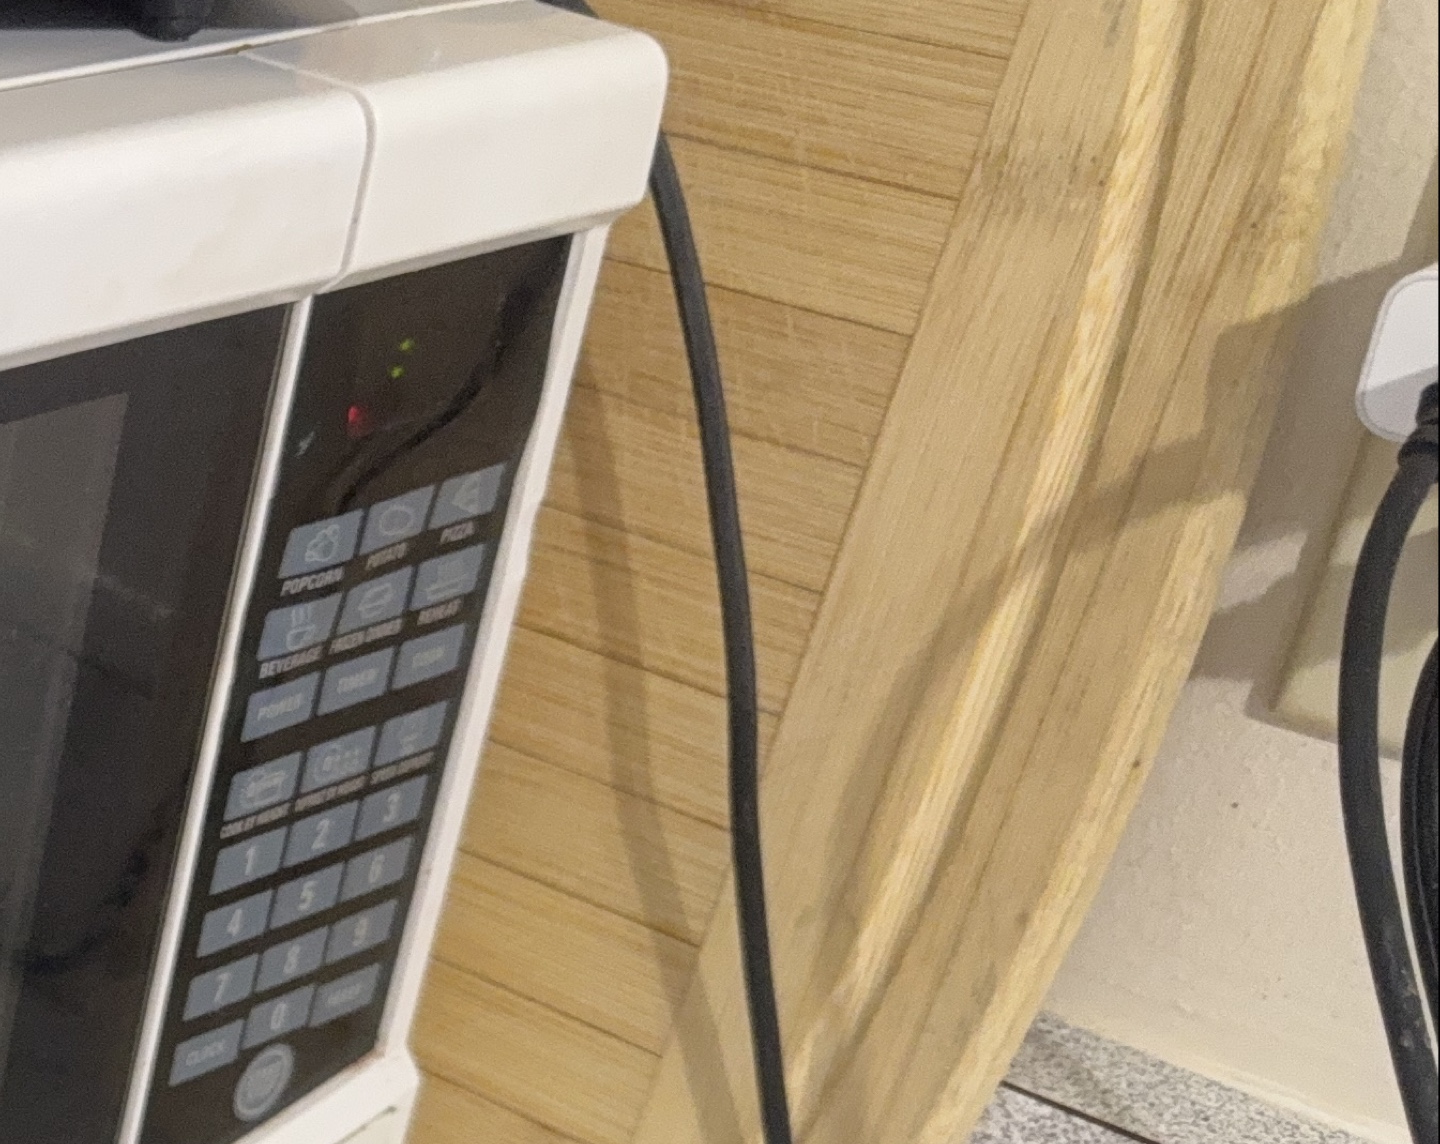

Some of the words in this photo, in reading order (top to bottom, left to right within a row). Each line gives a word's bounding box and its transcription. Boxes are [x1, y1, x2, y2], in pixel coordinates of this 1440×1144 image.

[280, 566, 345, 597] POPCORN
[258, 646, 321, 679] BEVERAGE
[383, 791, 400, 823] 3
[311, 818, 330, 850] 2
[244, 846, 256, 876] 1
[368, 854, 385, 884] 6
[298, 880, 319, 911] 5
[227, 908, 243, 937] 4
[353, 917, 368, 947] 9
[284, 943, 300, 974] 8
[214, 971, 231, 1002] 7
[271, 1002, 288, 1031] 0
